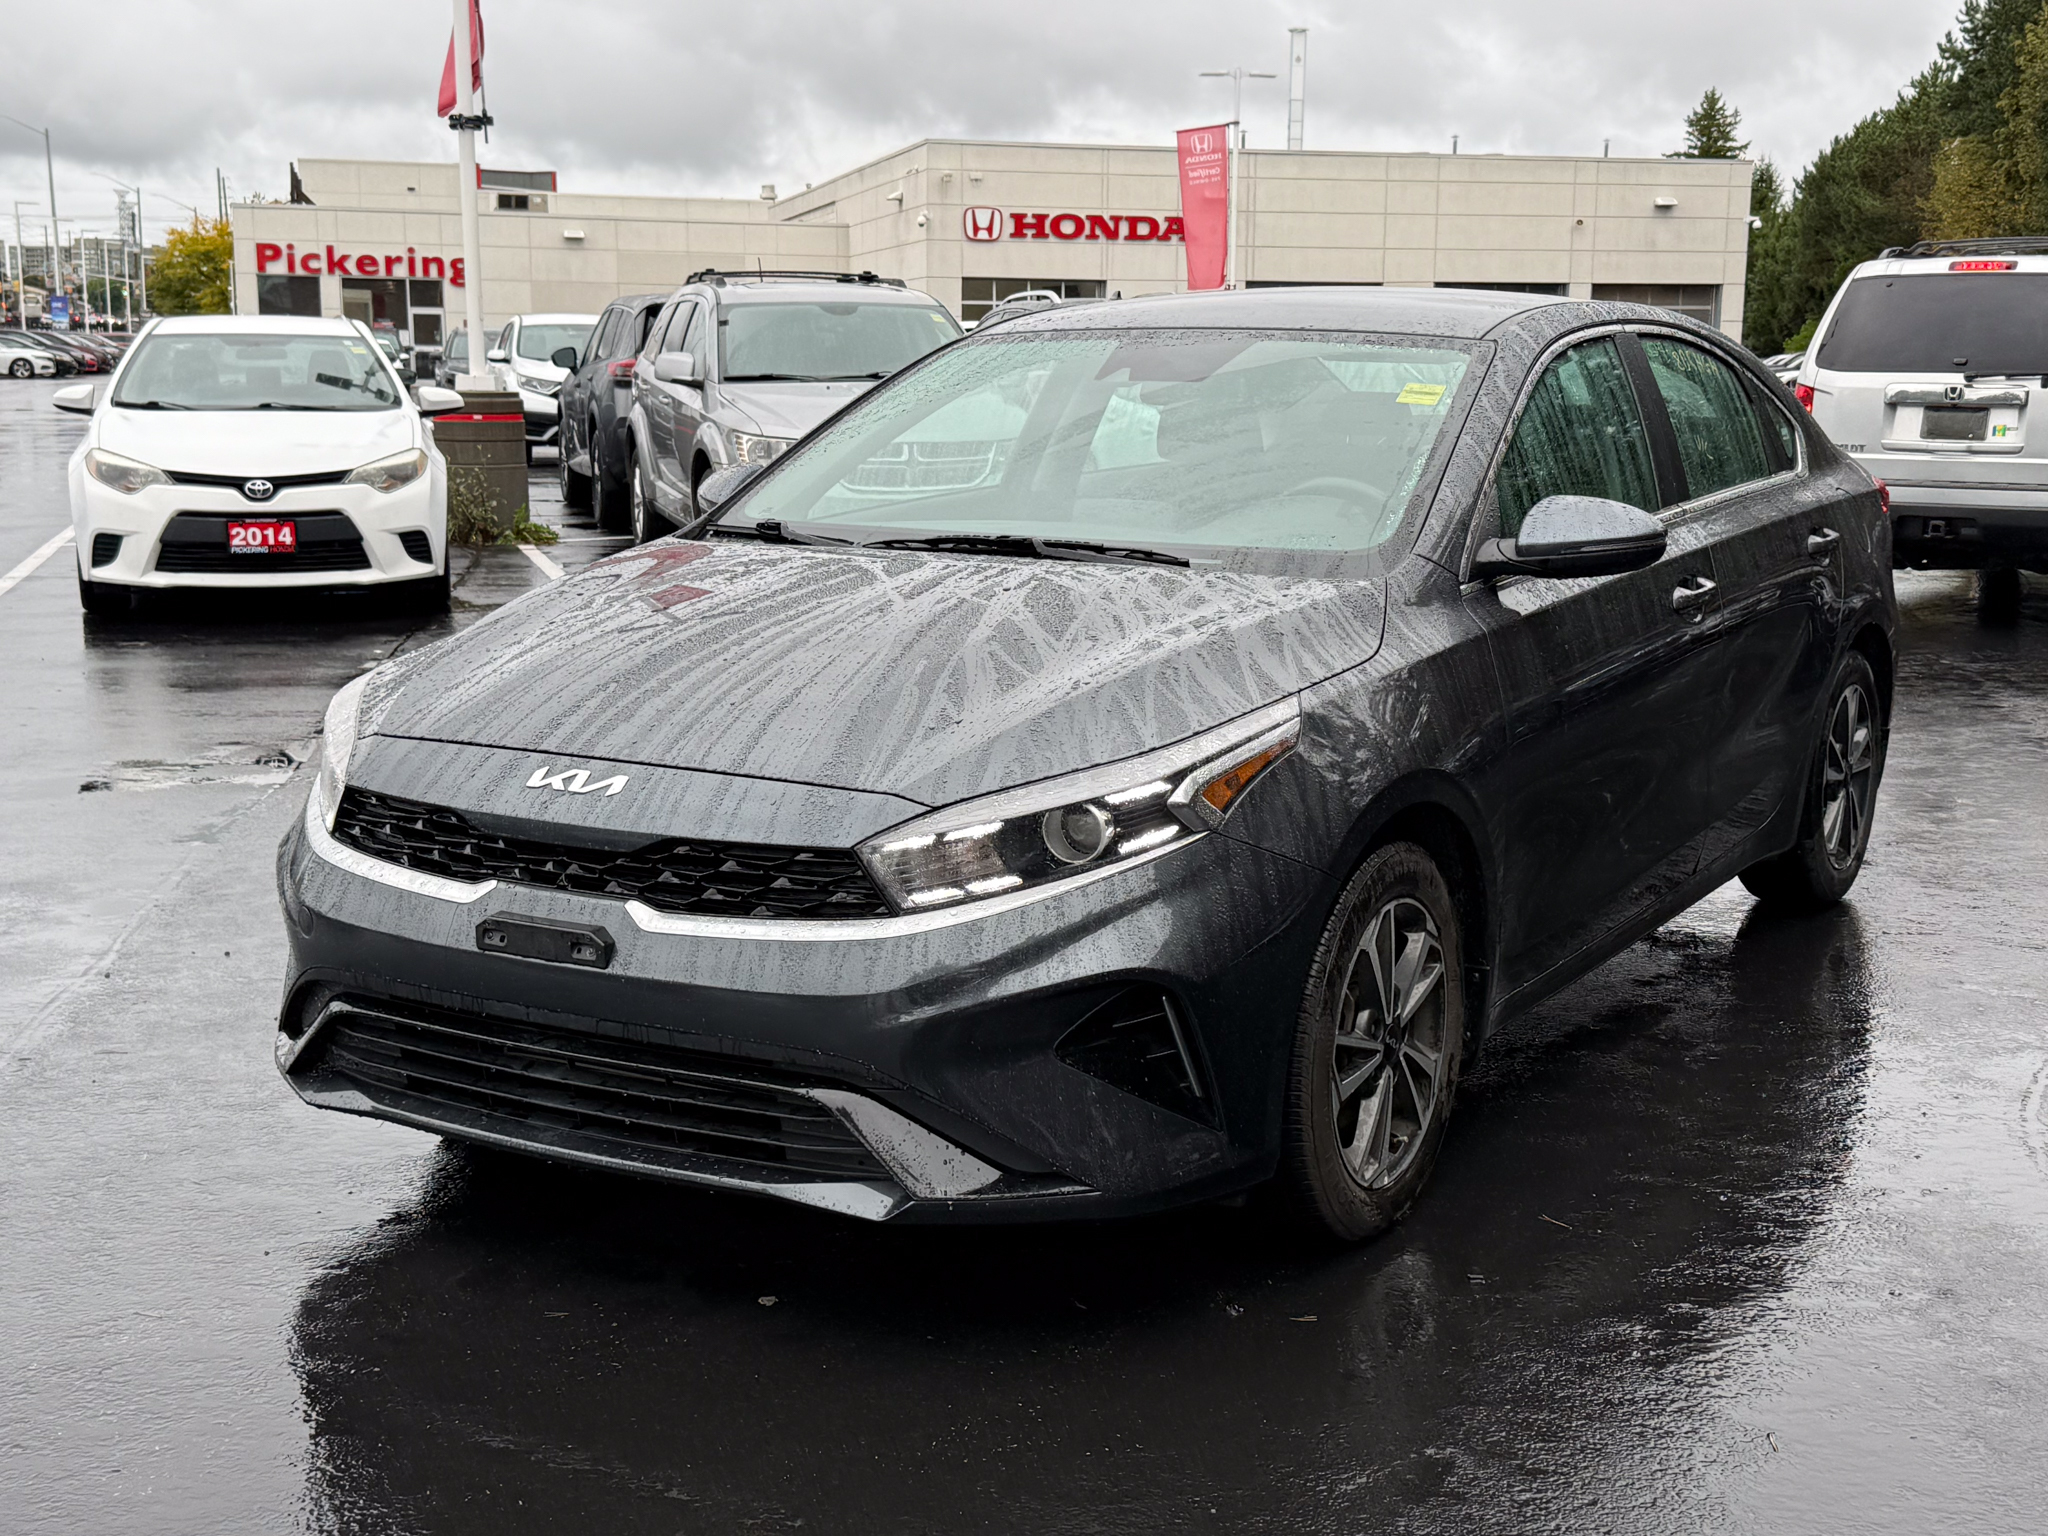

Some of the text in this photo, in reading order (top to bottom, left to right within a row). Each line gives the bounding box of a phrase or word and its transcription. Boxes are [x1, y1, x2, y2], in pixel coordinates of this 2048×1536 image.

[1009, 213, 1185, 242] HONDA
[256, 243, 465, 287] Pickering
[230, 527, 293, 546] 2014
[231, 545, 269, 554] PICKERING
